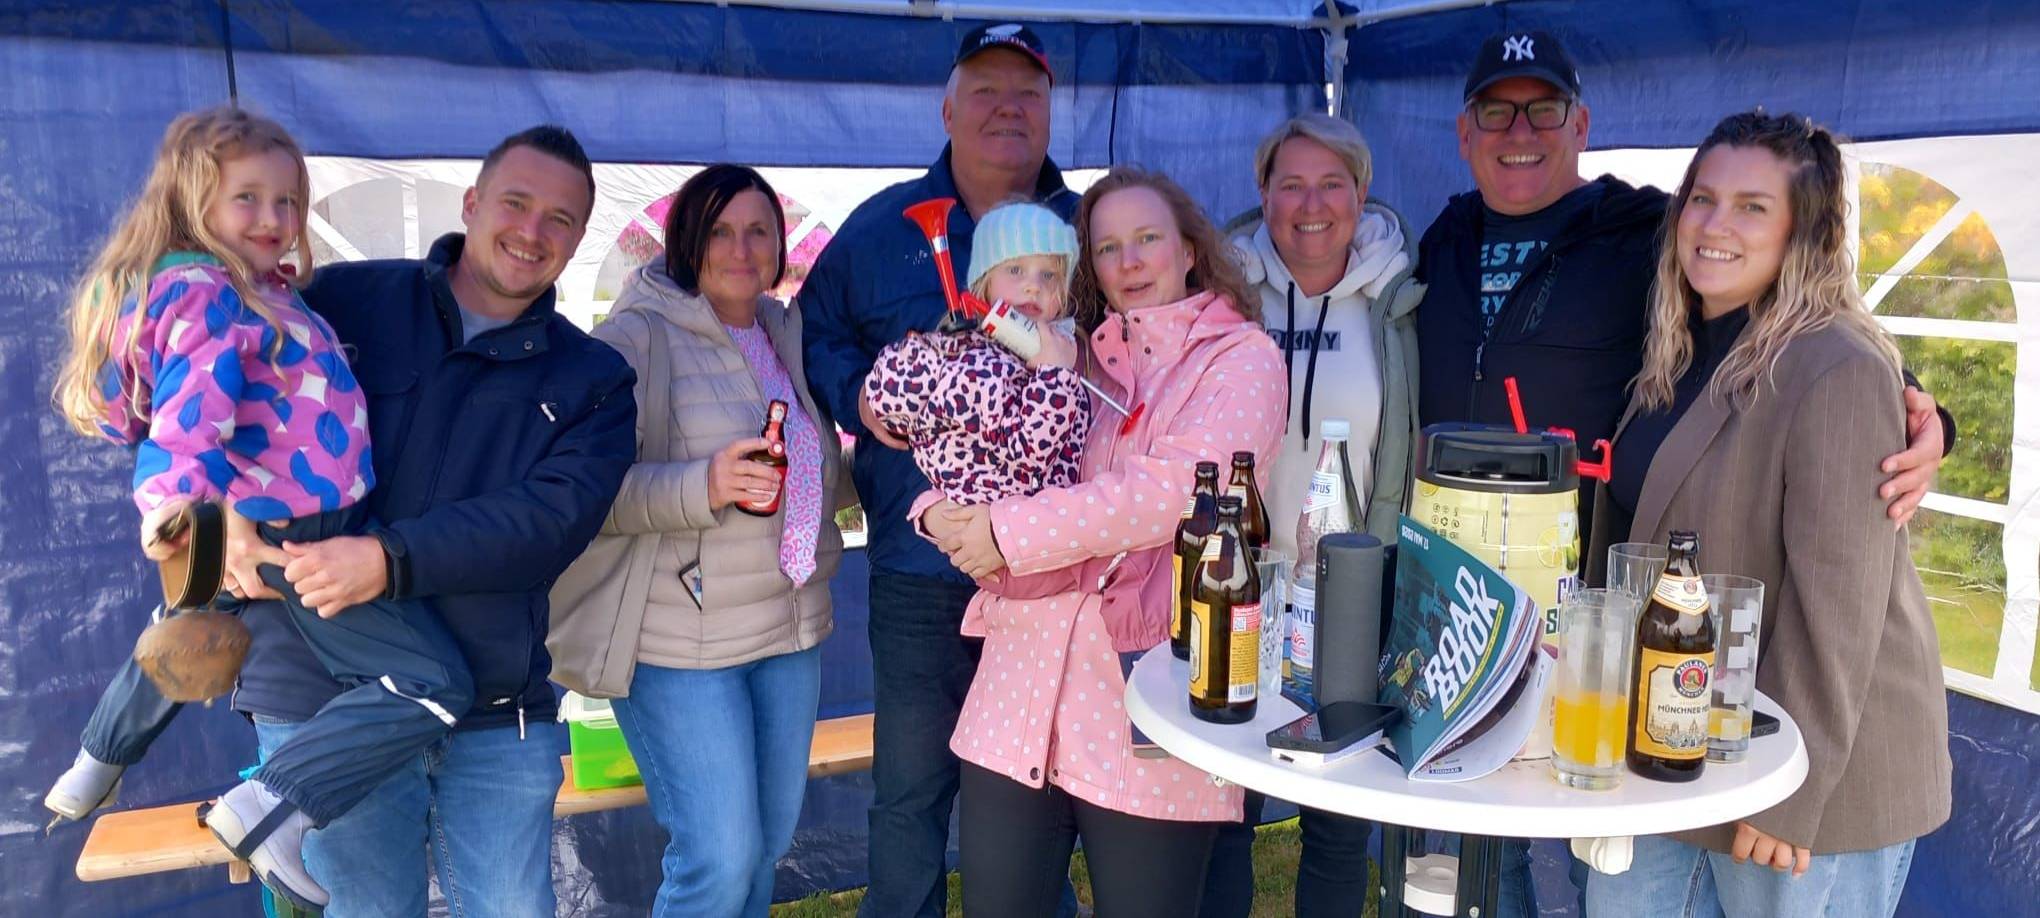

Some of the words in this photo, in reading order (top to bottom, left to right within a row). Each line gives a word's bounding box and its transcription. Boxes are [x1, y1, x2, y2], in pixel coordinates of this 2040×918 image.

[1503, 35, 1535, 61] NY
[1424, 566, 1477, 699] ROAD
[1438, 575, 1499, 713] BOOK
[1657, 703, 1701, 714] MÜNCHNER
